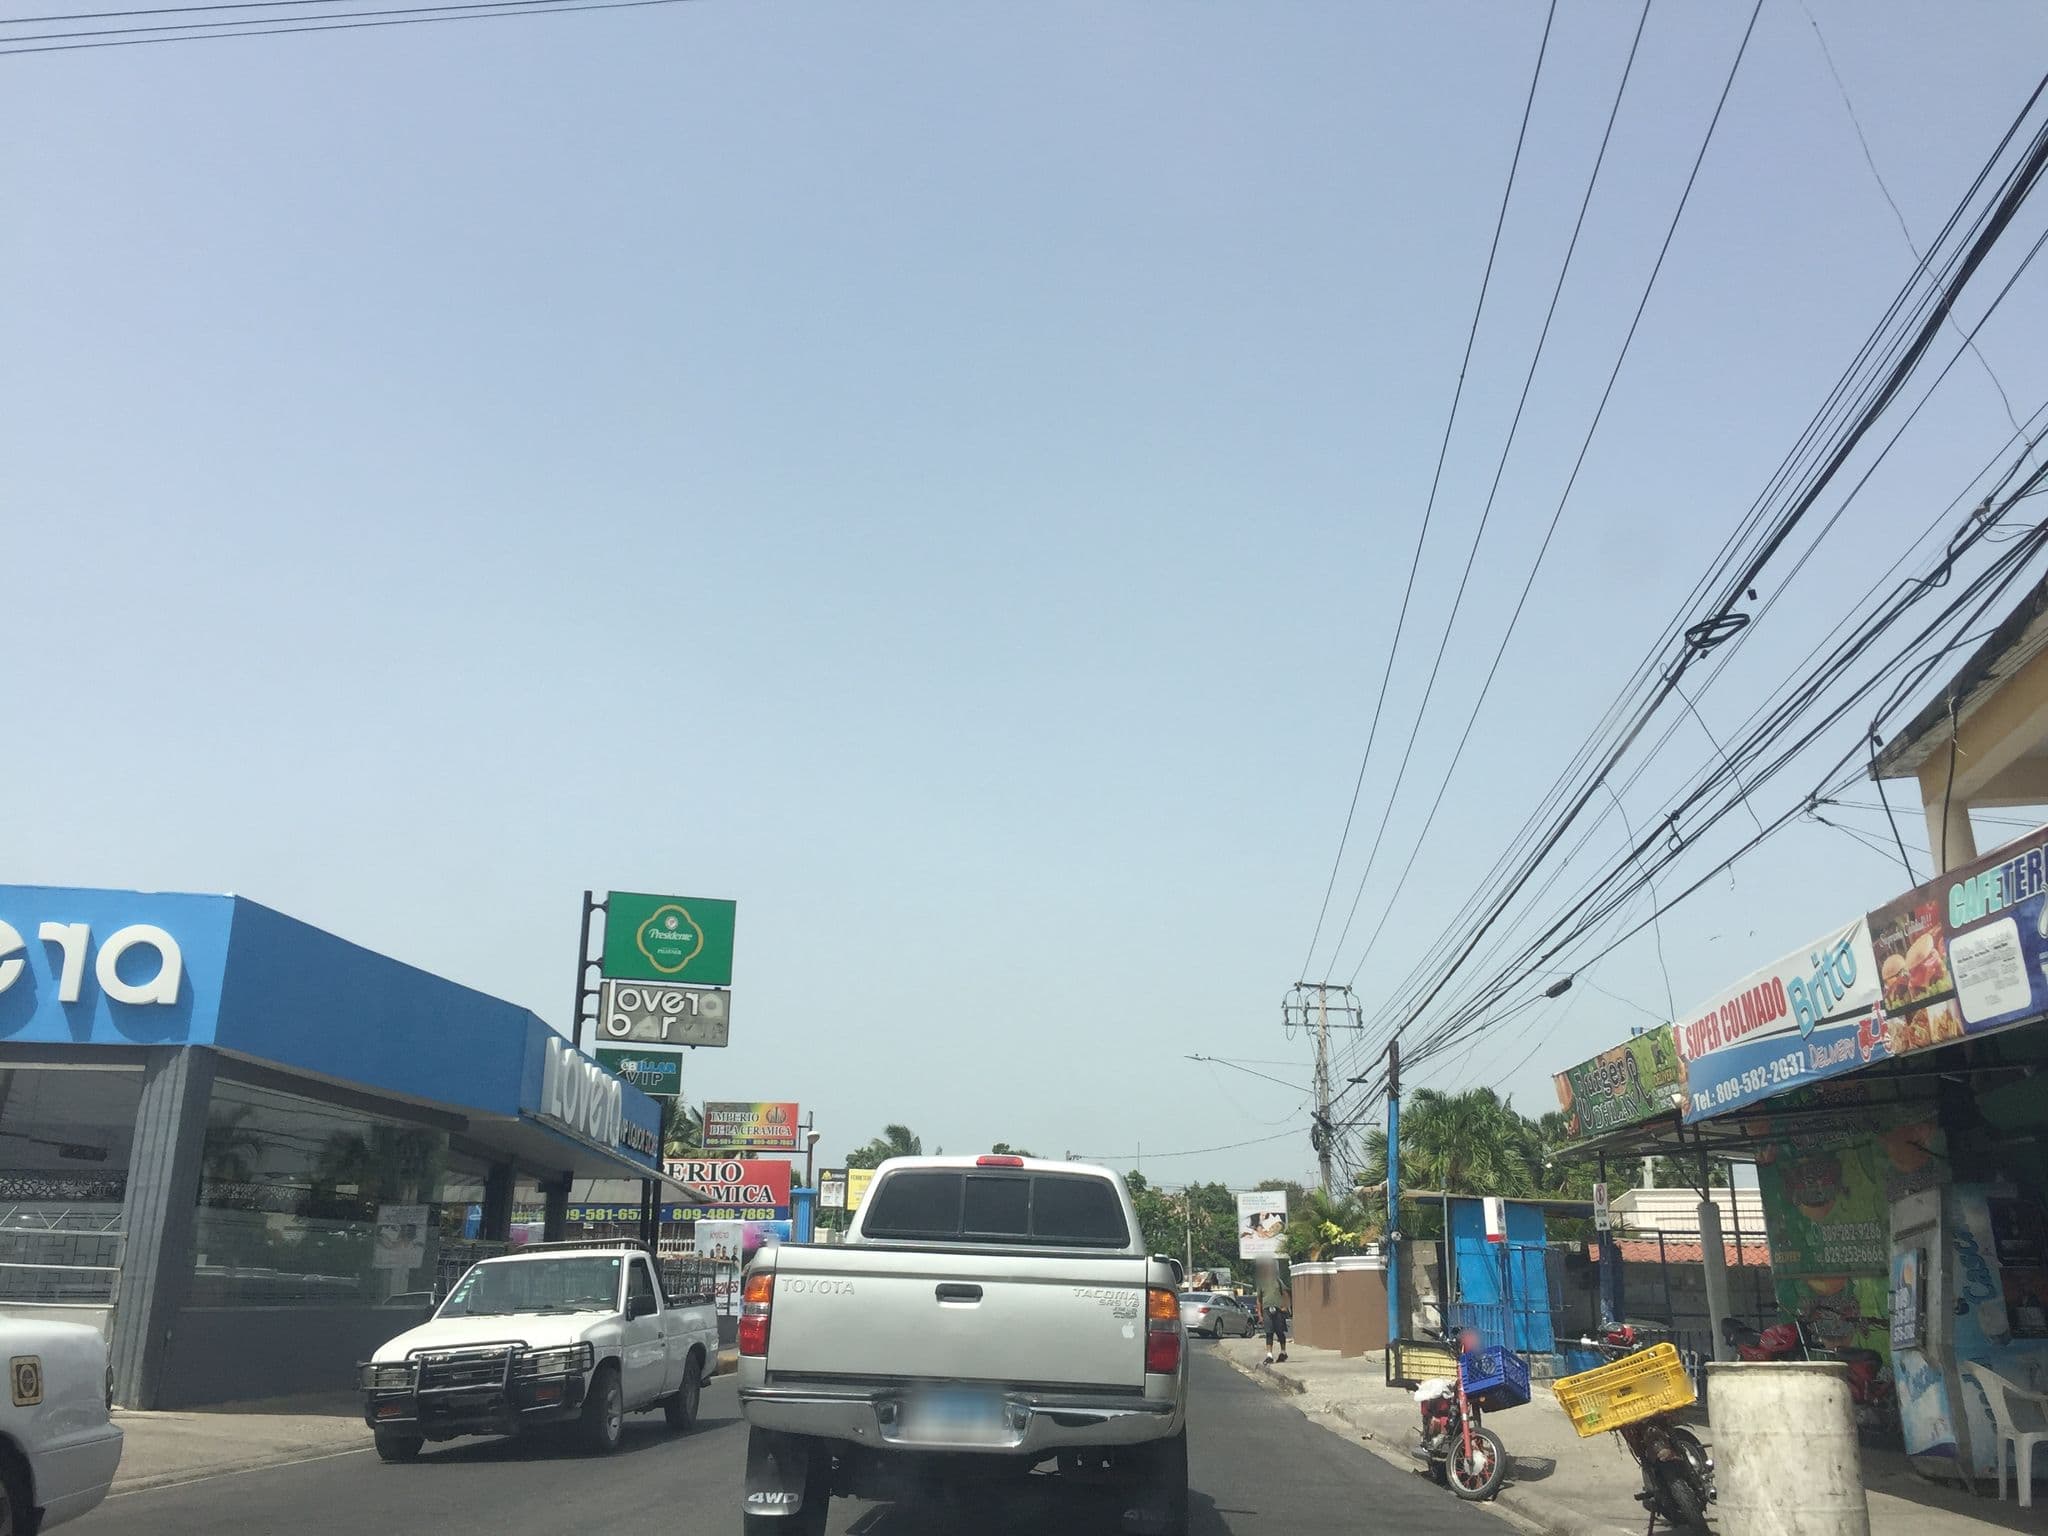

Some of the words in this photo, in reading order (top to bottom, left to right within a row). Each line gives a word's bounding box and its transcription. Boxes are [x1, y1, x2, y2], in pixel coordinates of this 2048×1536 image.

[1948, 843, 2048, 929] CAFETER
[648, 928, 693, 942] Presidente
[1786, 938, 1857, 1041] Brito
[1686, 1011, 1720, 1062] SUPER
[1719, 974, 1788, 1043] COLMADO
[625, 1071, 664, 1086] VIP
[1715, 1050, 1806, 1103] 809-582-2037
[710, 1111, 760, 1123] IMPERIO
[665, 1160, 746, 1184] ERIO
[671, 1207, 775, 1221] 809-480-7863
[781, 1279, 855, 1296] TOYOTA
[1073, 1287, 1140, 1302] TACOMA
[748, 1491, 800, 1505] 4WD
